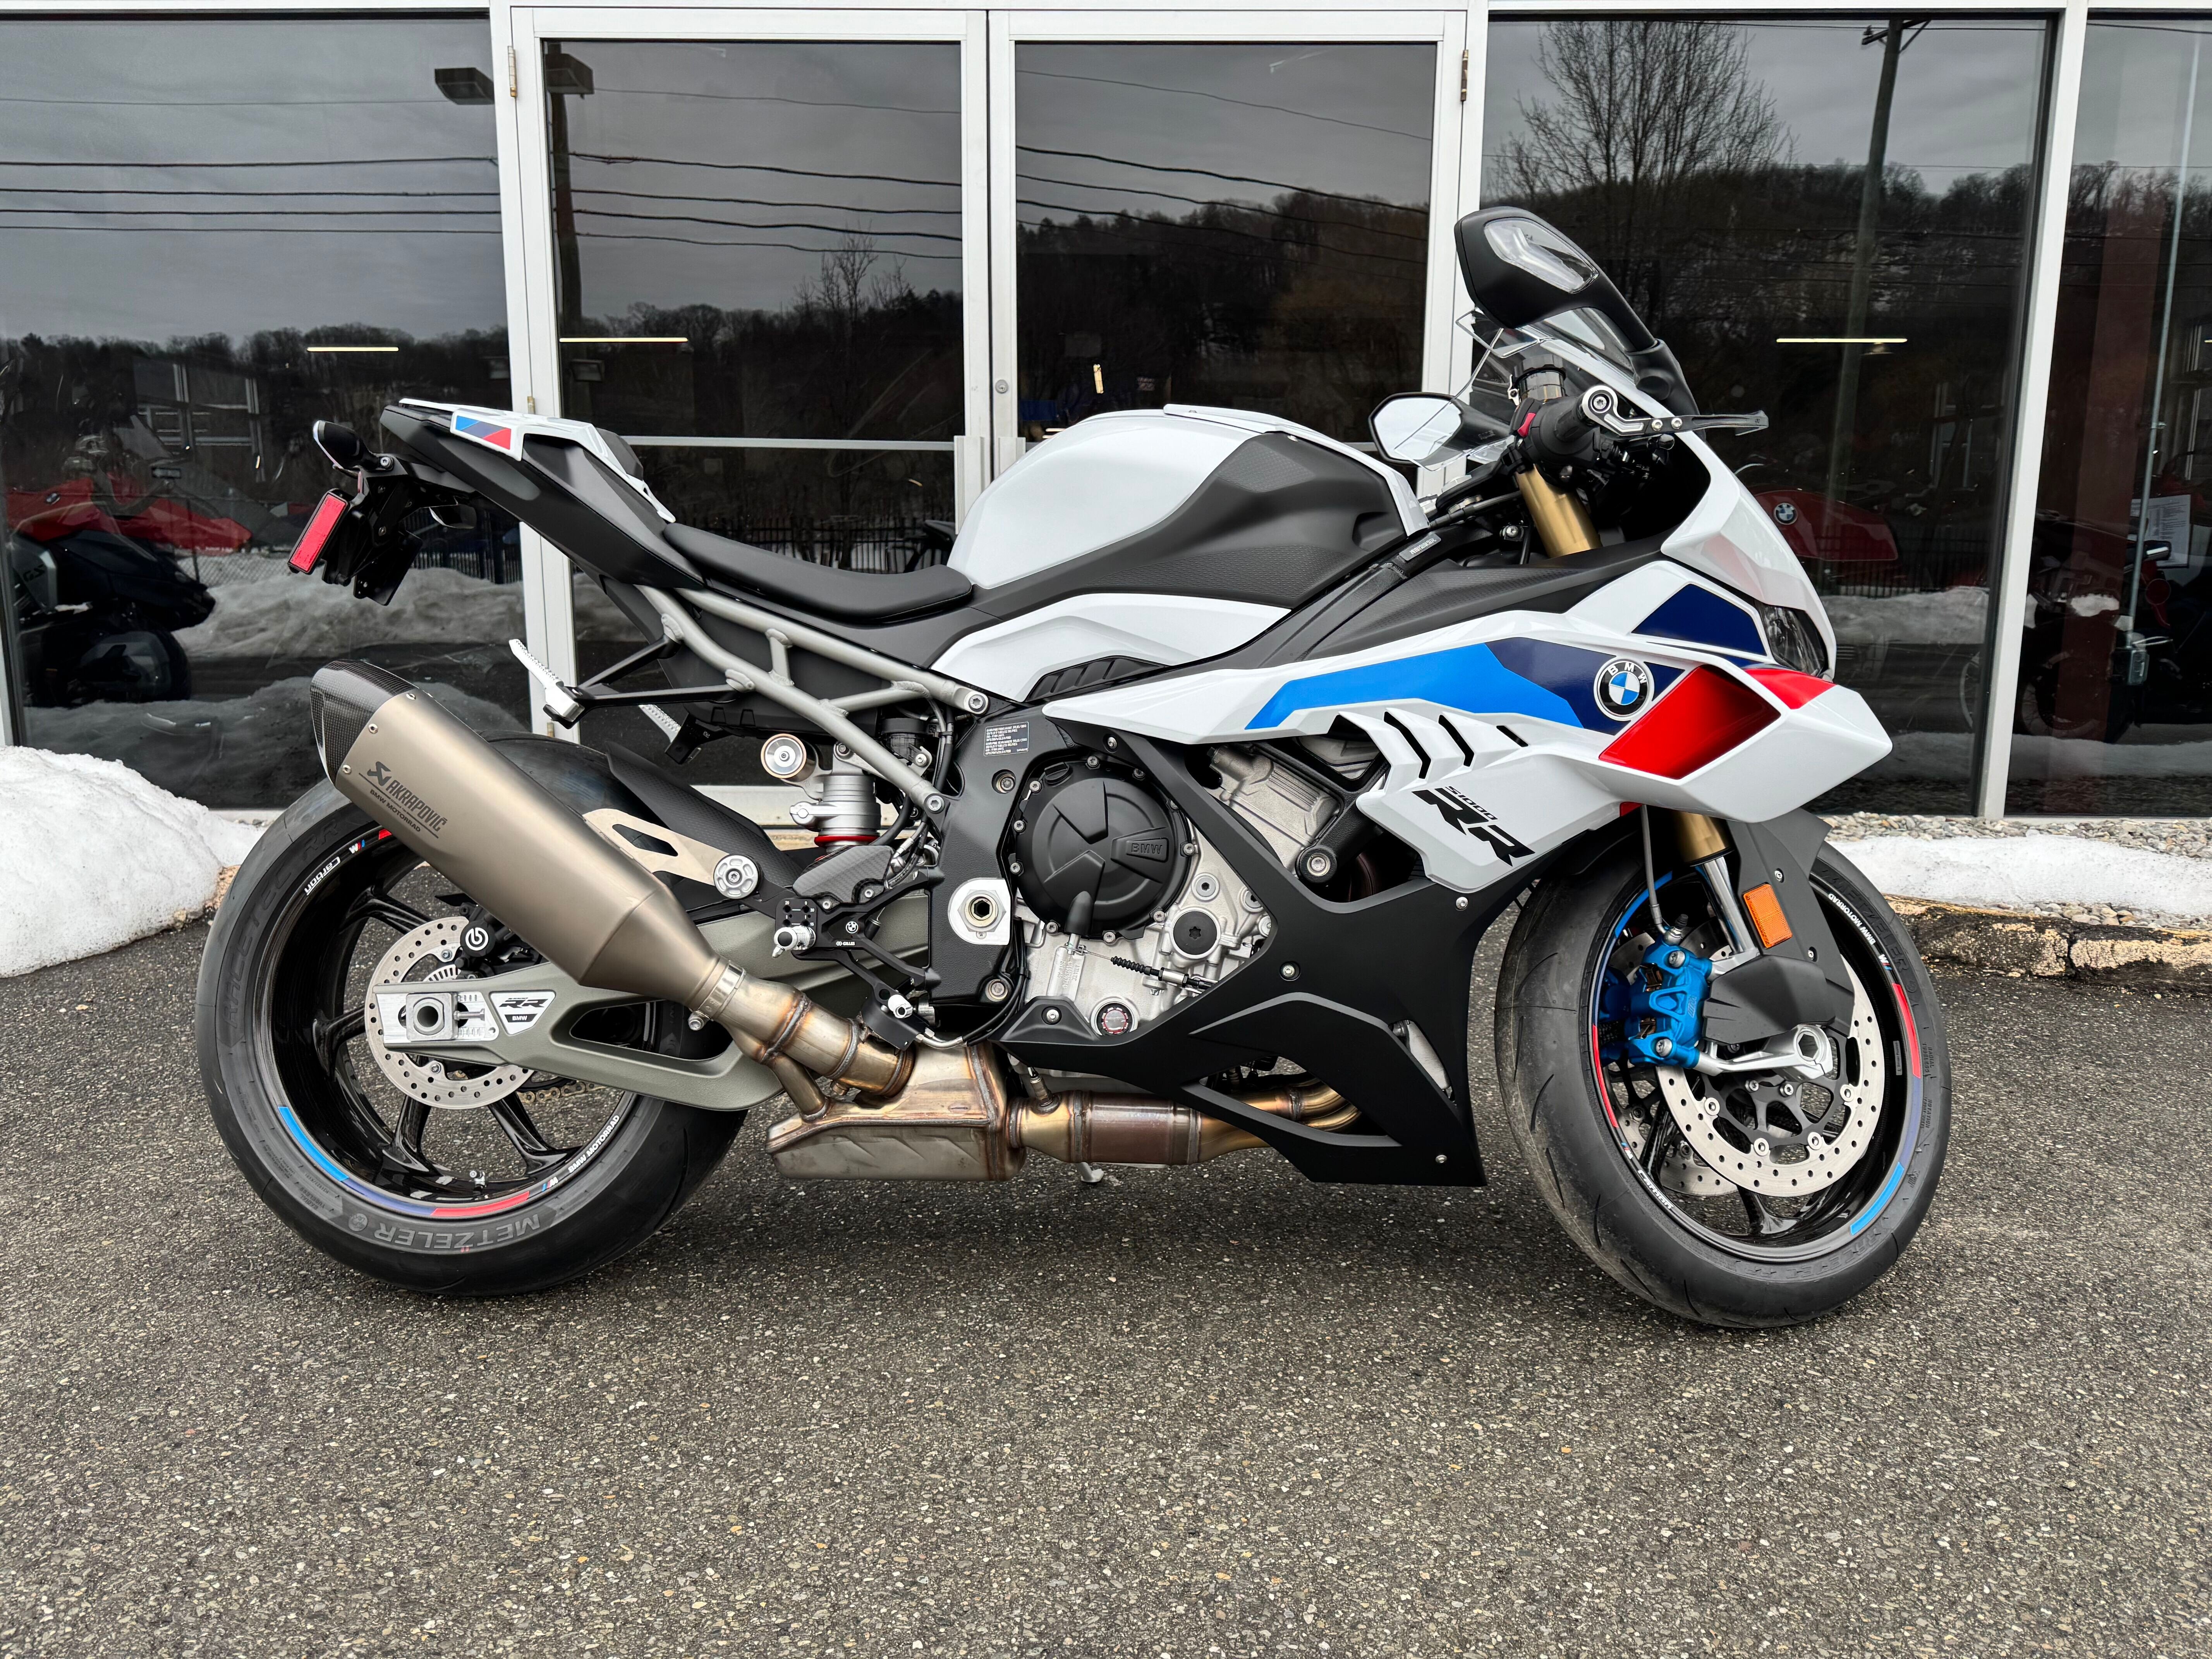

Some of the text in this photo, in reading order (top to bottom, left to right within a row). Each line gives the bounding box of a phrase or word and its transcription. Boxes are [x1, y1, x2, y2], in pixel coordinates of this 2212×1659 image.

[1607, 663, 1647, 684] BMW
[370, 789, 386, 804] BMW
[387, 803, 421, 832] MOTORRAD
[1412, 788, 1535, 867] RR
[1131, 843, 1163, 854] BMW
[1828, 893, 1876, 945] BMW MOTORRAD
[499, 999, 548, 1008] RR
[568, 1115, 620, 1173] BMW MOTORRAD
[374, 1214, 541, 1249] METZELER
